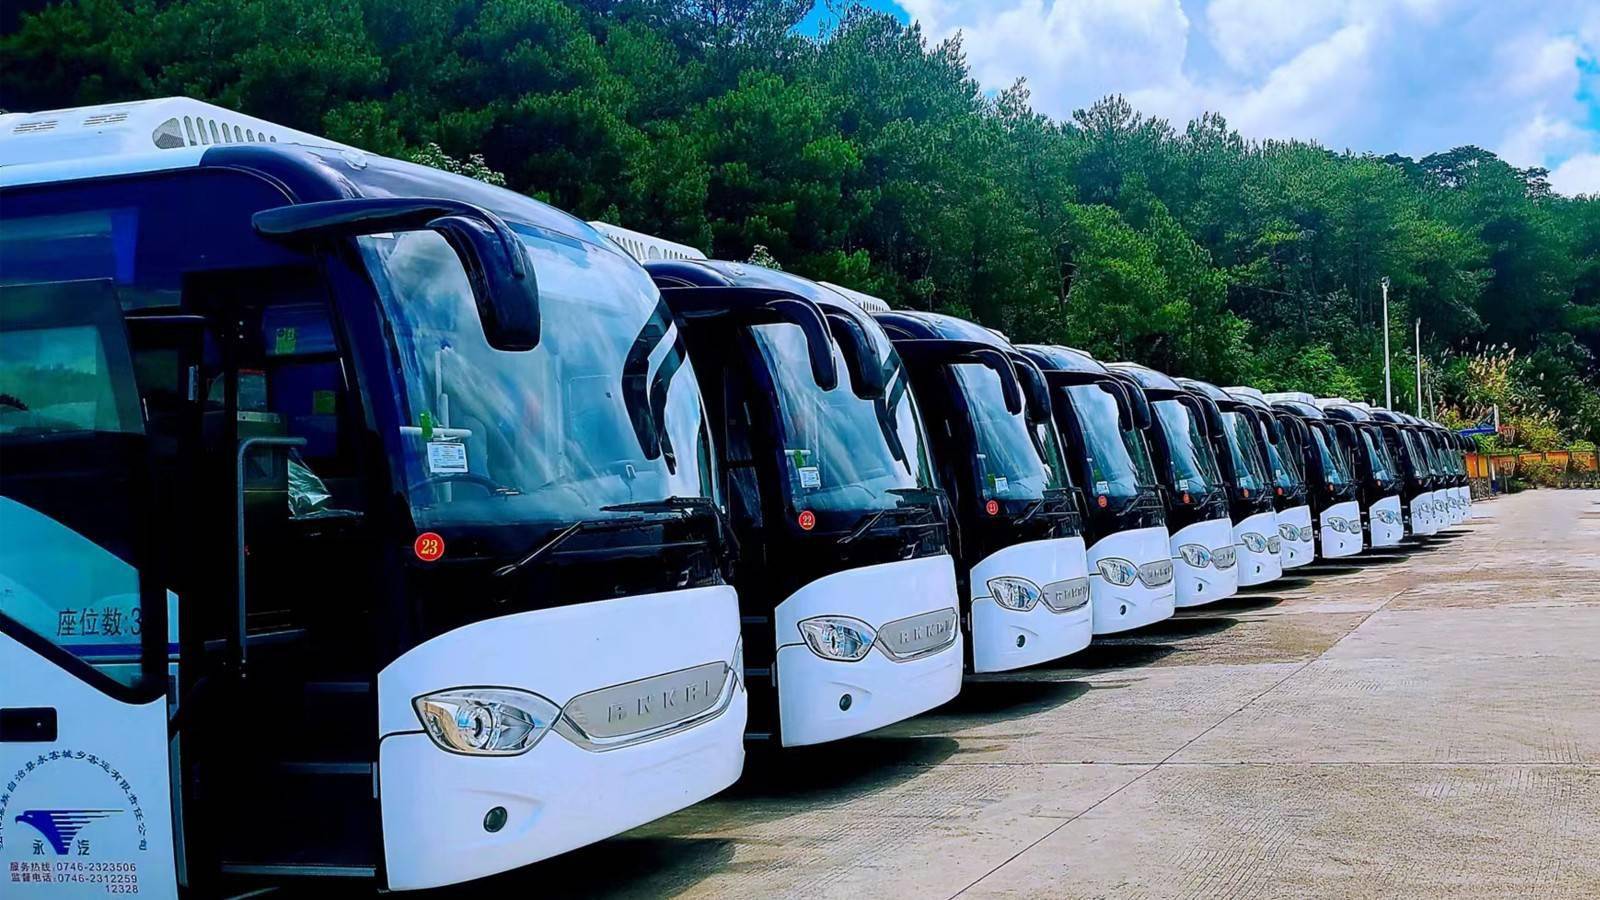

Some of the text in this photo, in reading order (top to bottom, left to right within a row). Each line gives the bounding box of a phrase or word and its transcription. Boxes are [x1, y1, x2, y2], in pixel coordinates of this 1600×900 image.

[802, 515, 812, 526] 22
[421, 539, 438, 554] 23
[57, 607, 142, 636] 座位数:3
[105, 884, 139, 894] 12328
